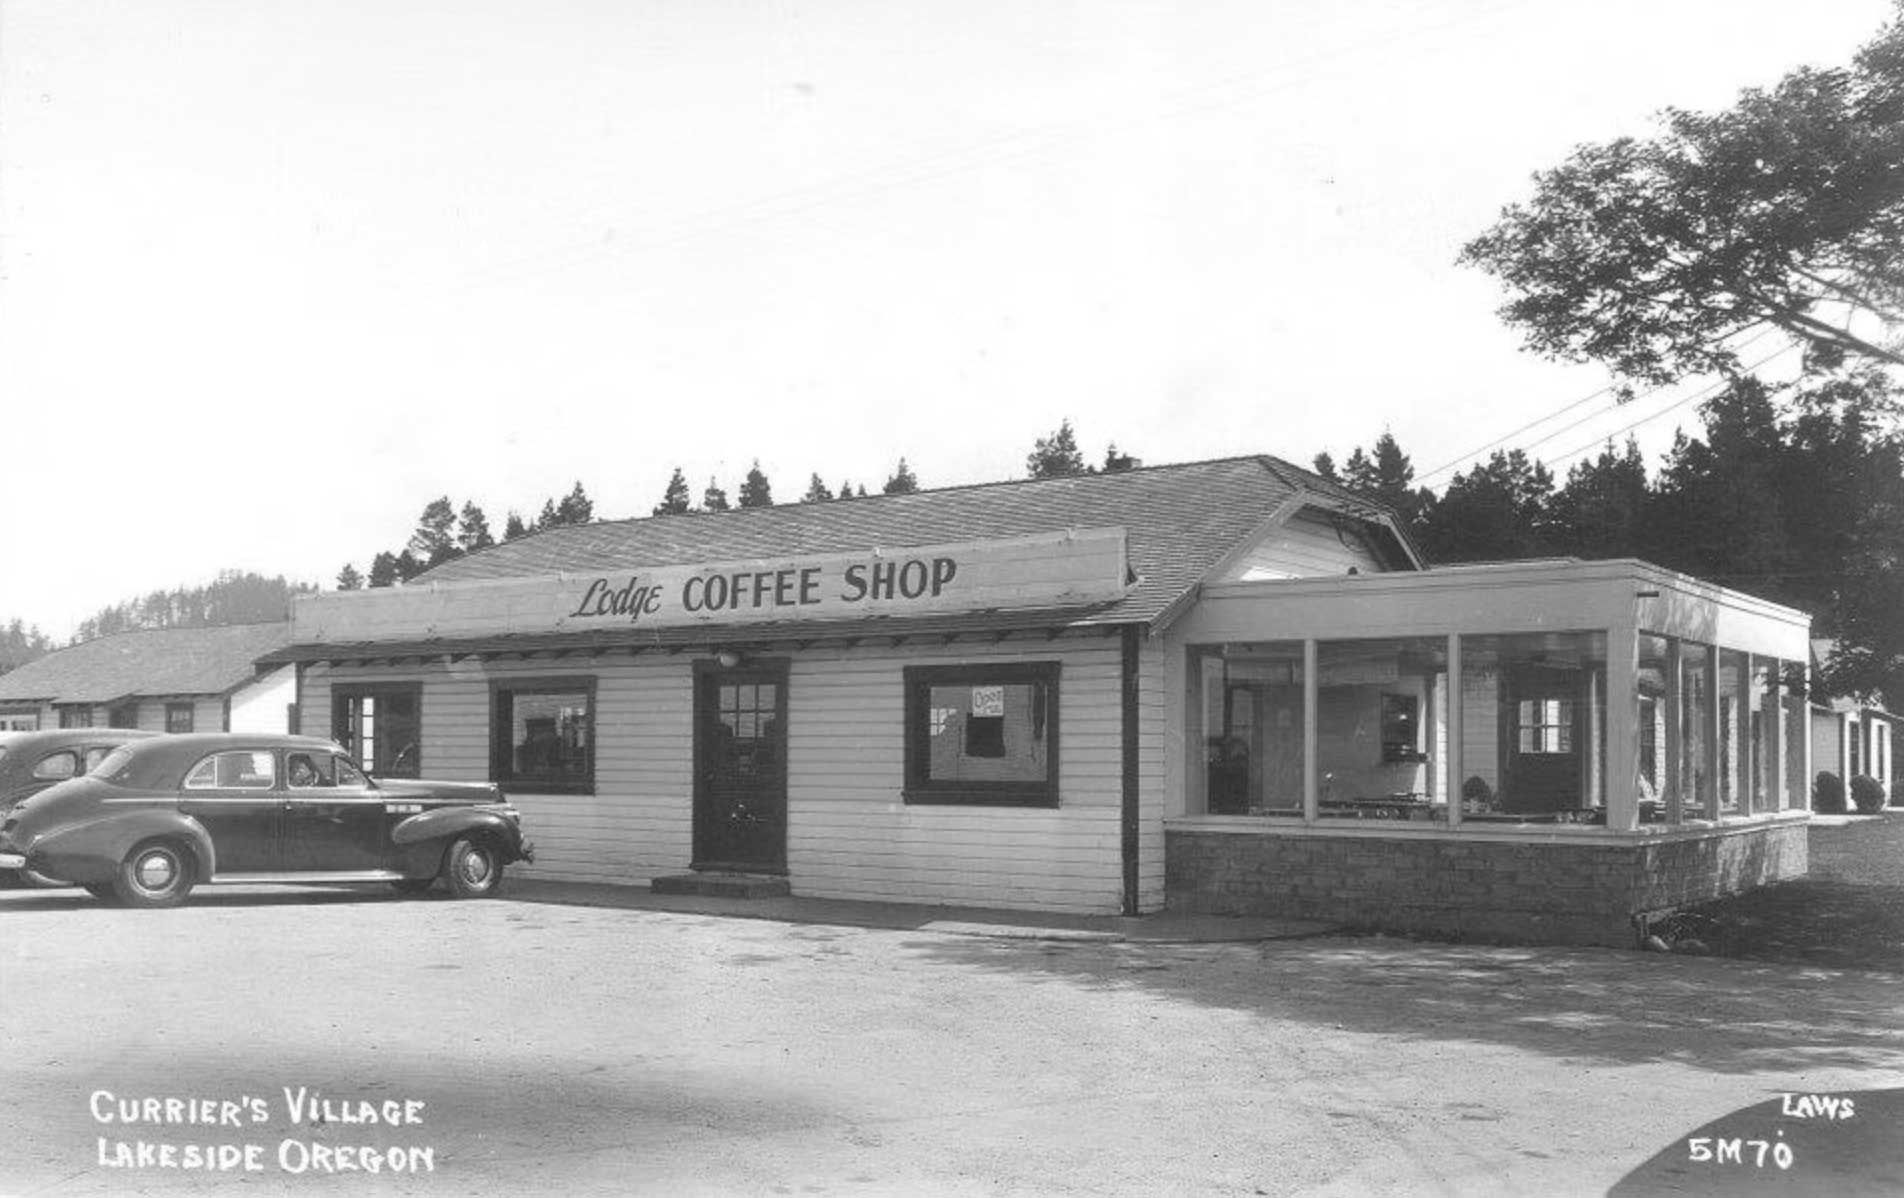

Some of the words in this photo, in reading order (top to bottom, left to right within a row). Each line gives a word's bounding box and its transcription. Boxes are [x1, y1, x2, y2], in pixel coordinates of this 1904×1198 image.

[569, 576, 664, 624] Lodge
[682, 567, 822, 612] COFFEE
[840, 558, 957, 602] SHOP
